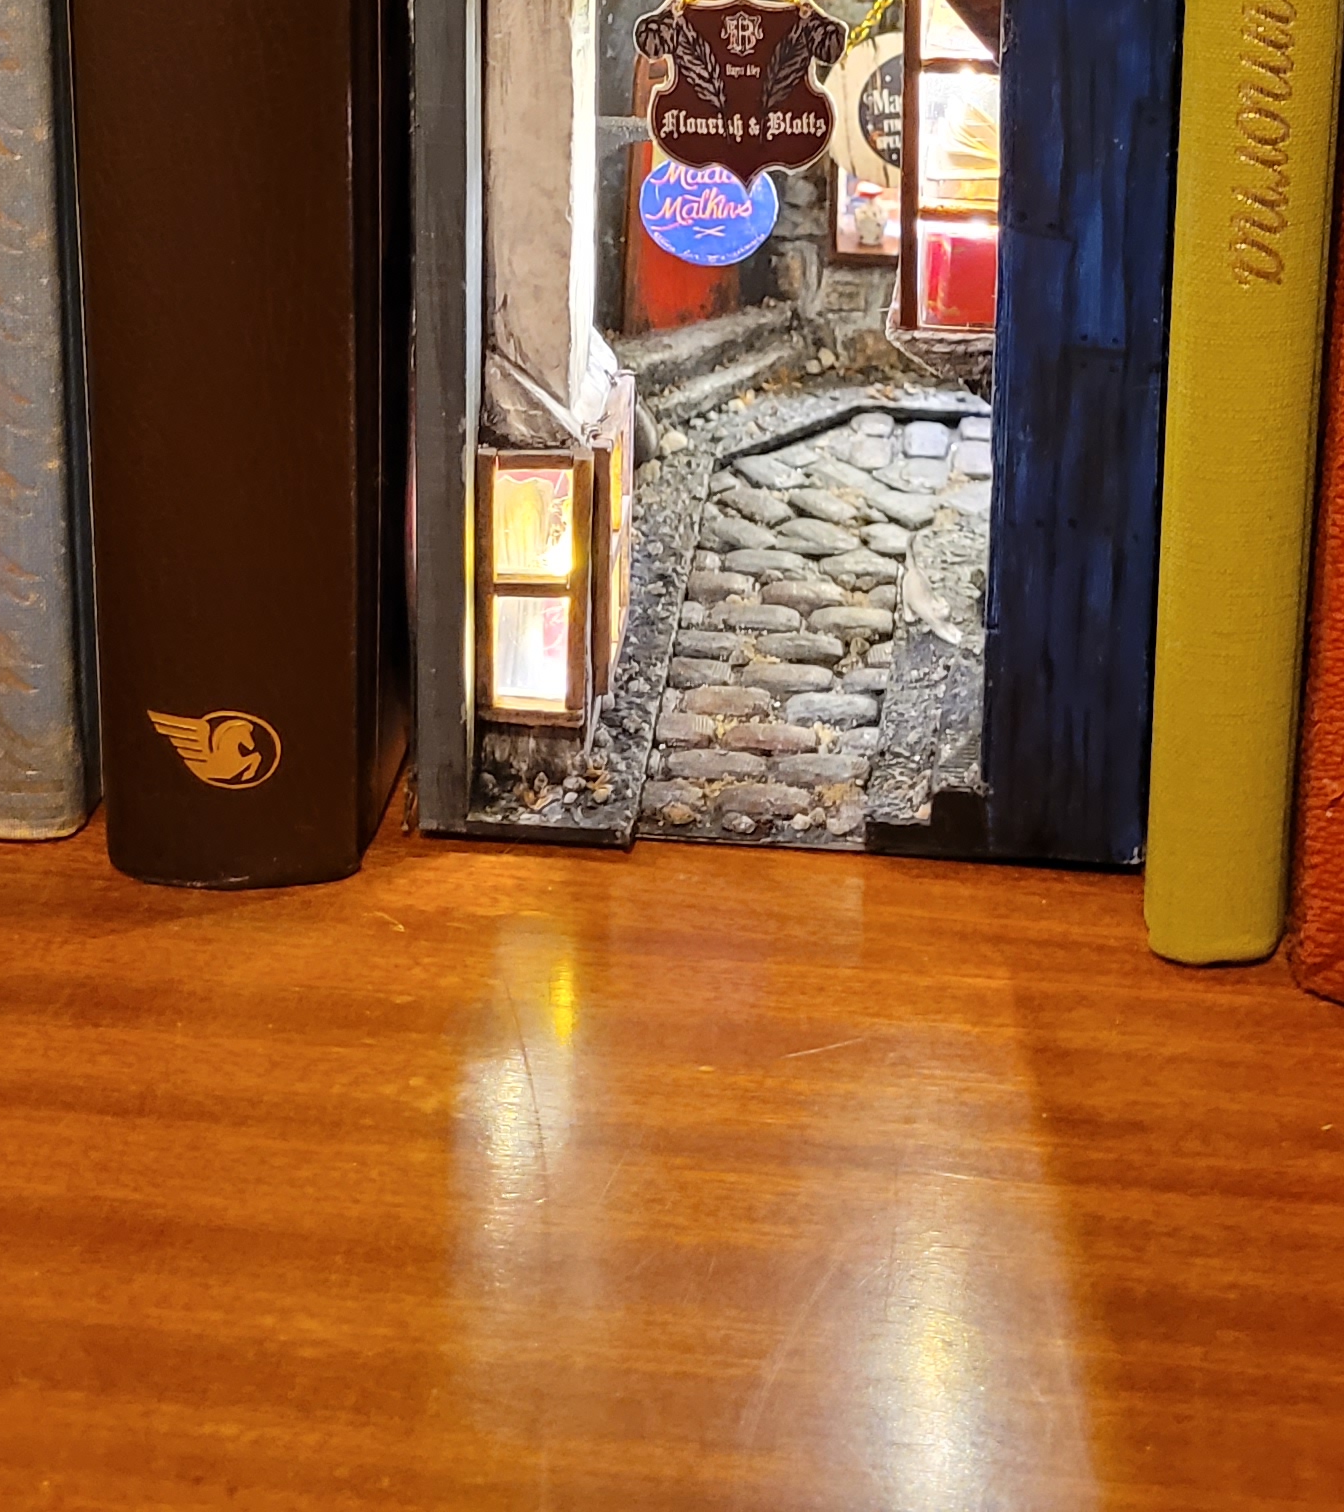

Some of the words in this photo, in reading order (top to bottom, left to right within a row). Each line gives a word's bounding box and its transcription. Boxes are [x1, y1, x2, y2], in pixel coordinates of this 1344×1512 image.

[748, 116, 760, 136] &
[649, 161, 738, 190] Mada
[645, 187, 753, 226] Malkins
